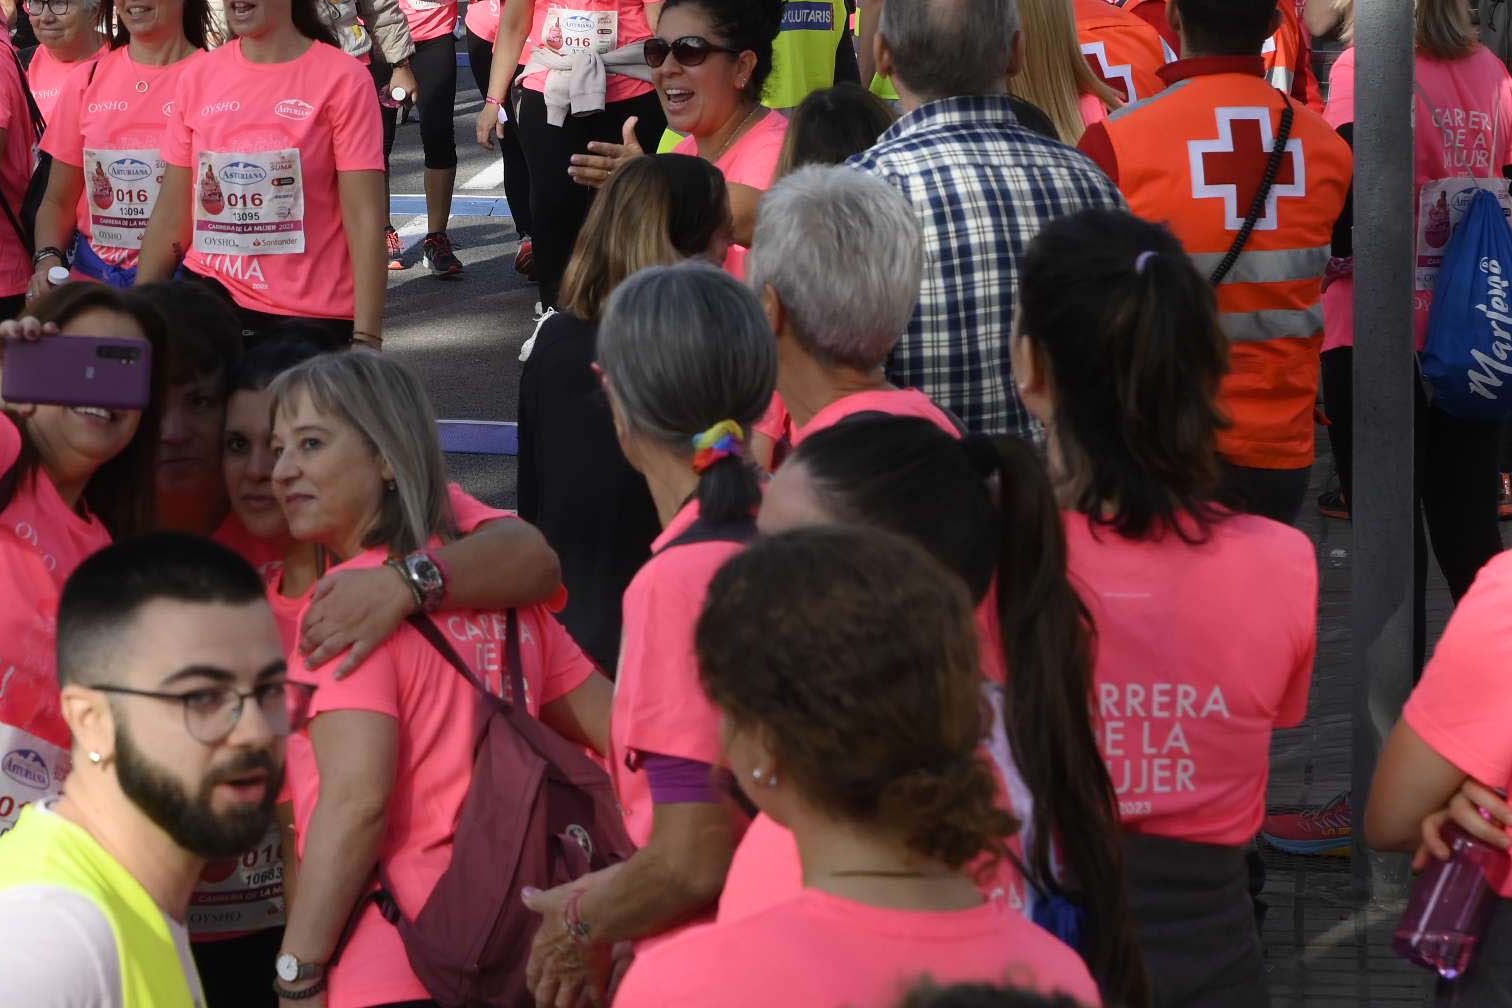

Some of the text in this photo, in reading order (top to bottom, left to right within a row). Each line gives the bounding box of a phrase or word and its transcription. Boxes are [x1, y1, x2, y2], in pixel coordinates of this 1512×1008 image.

[565, 36, 591, 48] 016
[88, 100, 128, 113] OYSHO
[200, 100, 240, 116] OYSHO
[111, 165, 150, 177] ASTURIANA
[223, 169, 265, 180] ASTURIANA
[116, 188, 148, 203] 016
[227, 192, 263, 207] 016
[207, 223, 235, 231] CARRERA
[244, 224, 253, 232] LA
[253, 224, 276, 232] MUJER
[98, 232, 122, 241] OYSHO
[204, 237, 297, 247] OYSHO Santander
[1090, 682, 1230, 719] RRERA
[1143, 722, 1191, 755] LA
